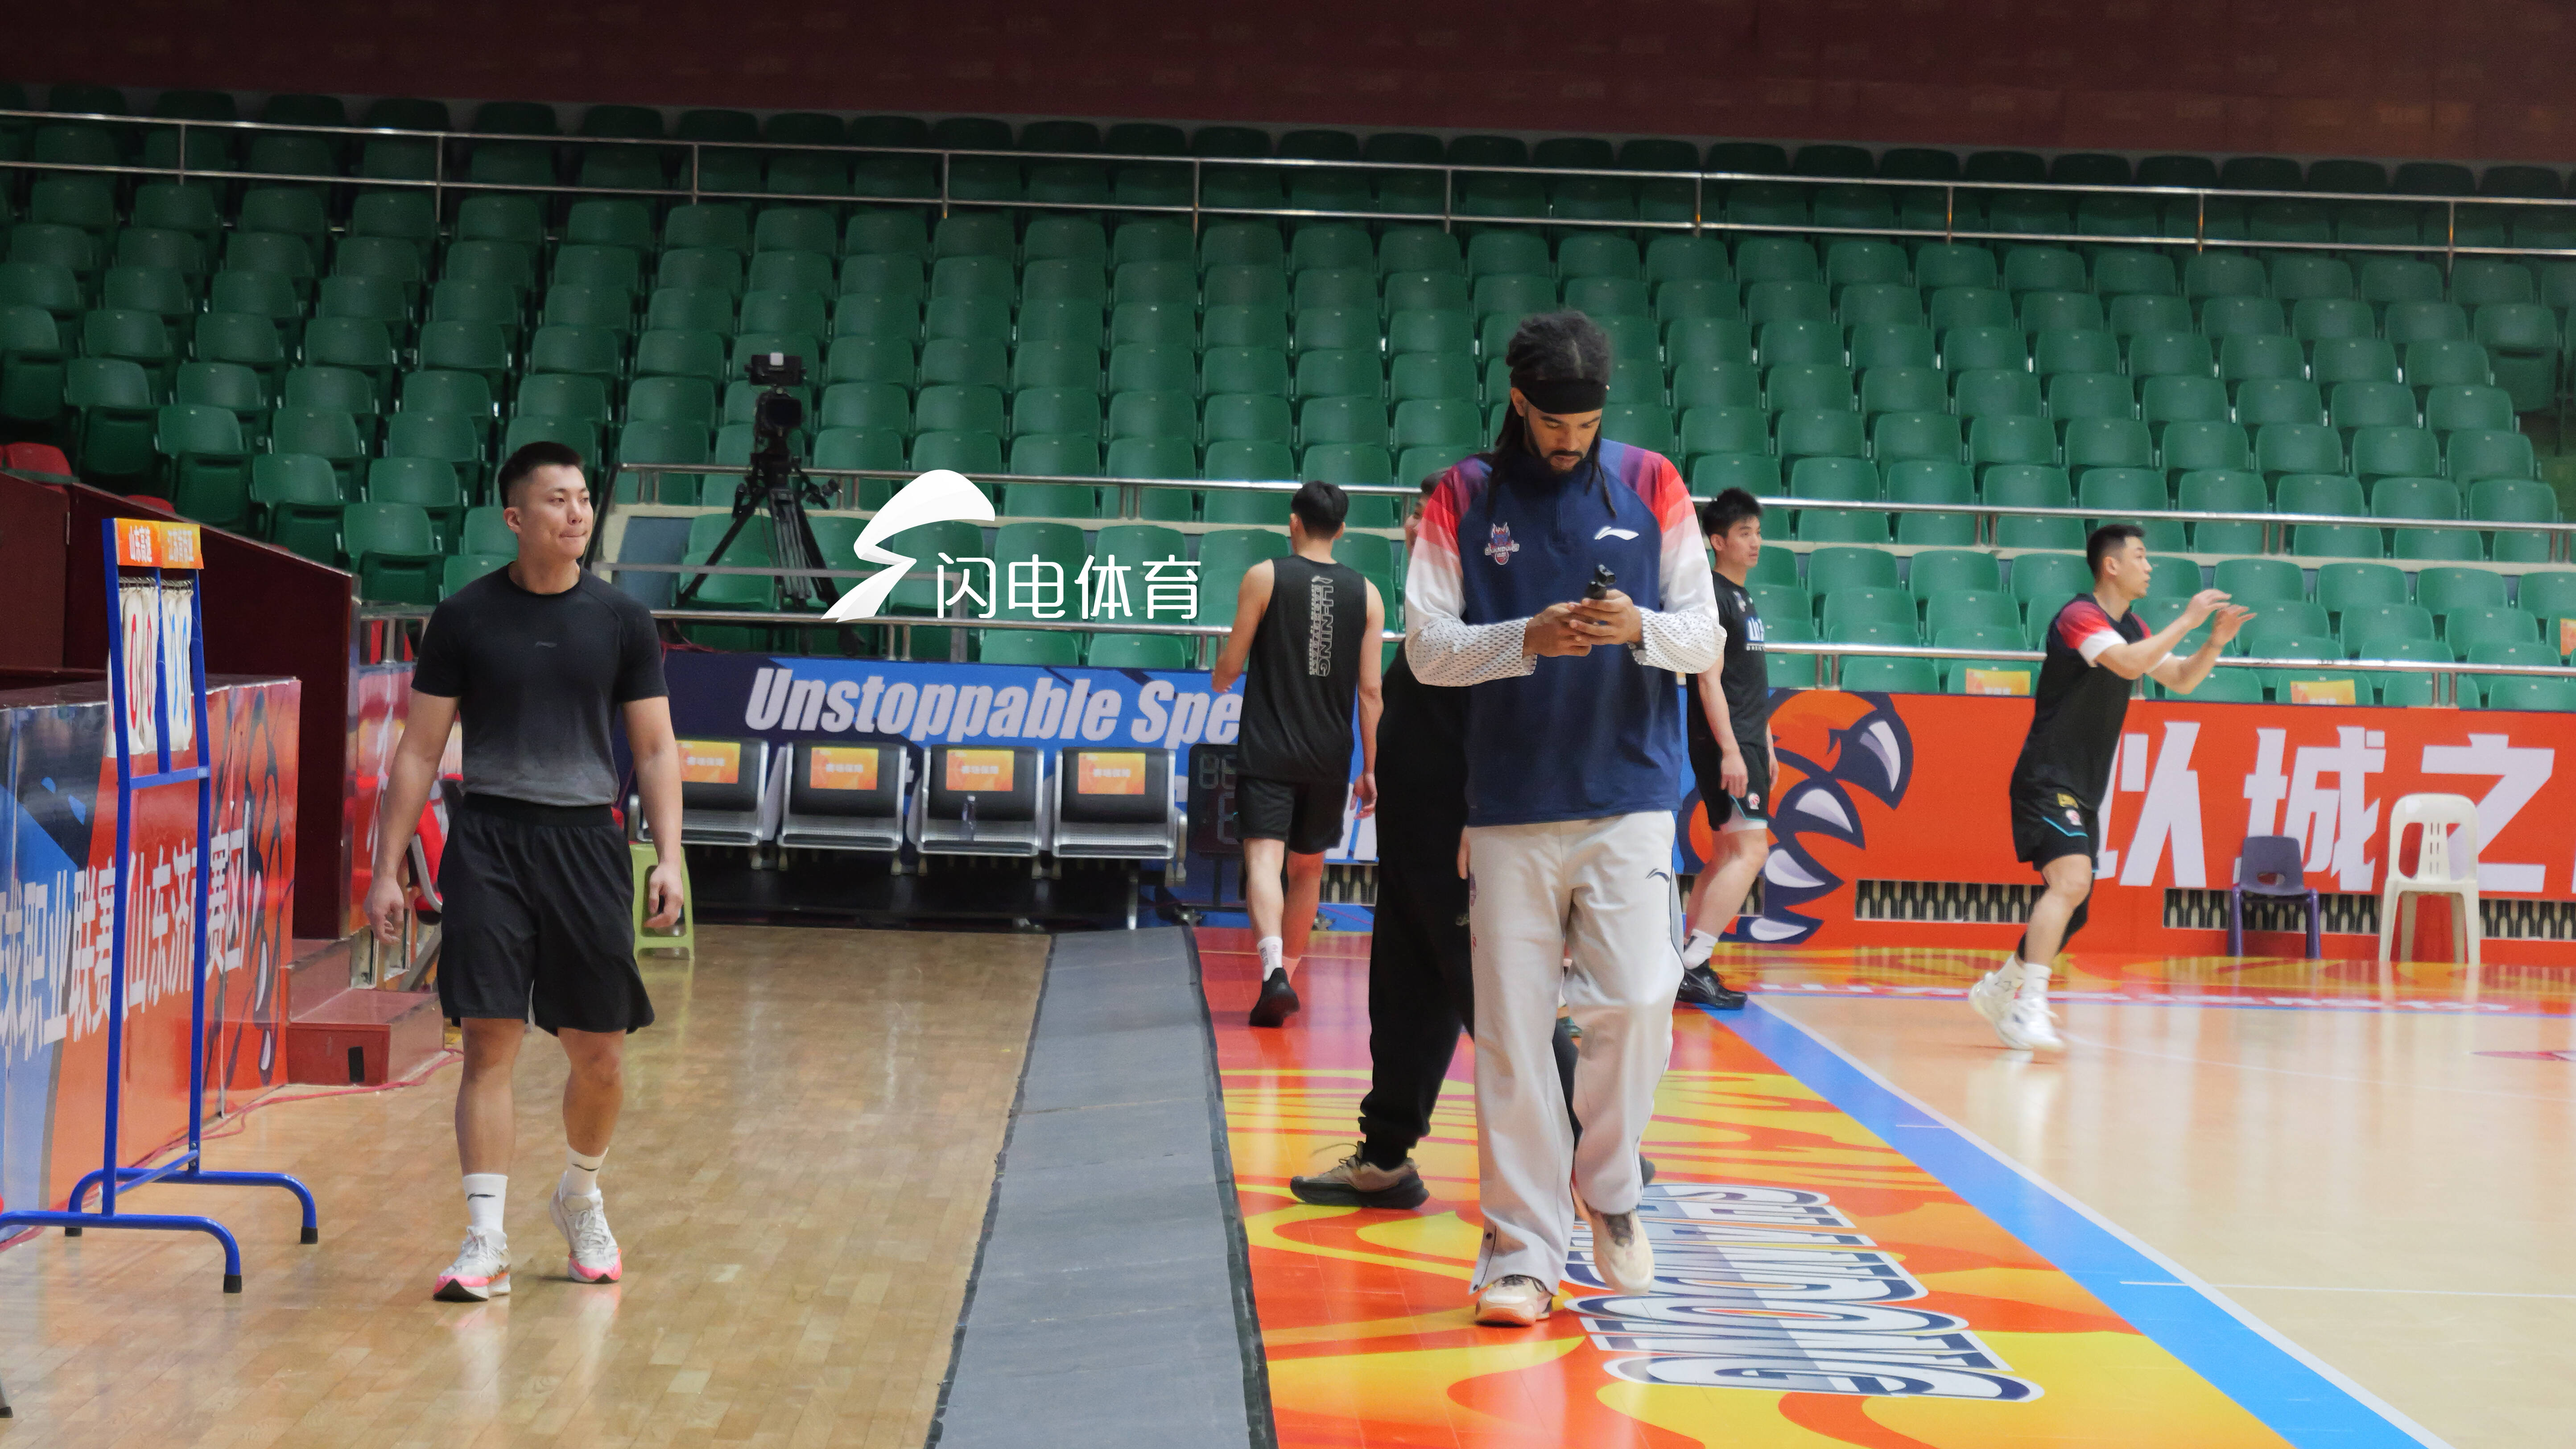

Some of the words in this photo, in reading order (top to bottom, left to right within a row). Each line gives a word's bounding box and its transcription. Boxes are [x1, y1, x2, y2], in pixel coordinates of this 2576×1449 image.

[129, 525, 152, 563] 山东高速
[1317, 585, 1333, 677] LI-NING
[745, 667, 1122, 742] Unstoppable
[2093, 721, 2576, 893] 以城之
[1563, 1183, 2045, 1402] SHANDONG
